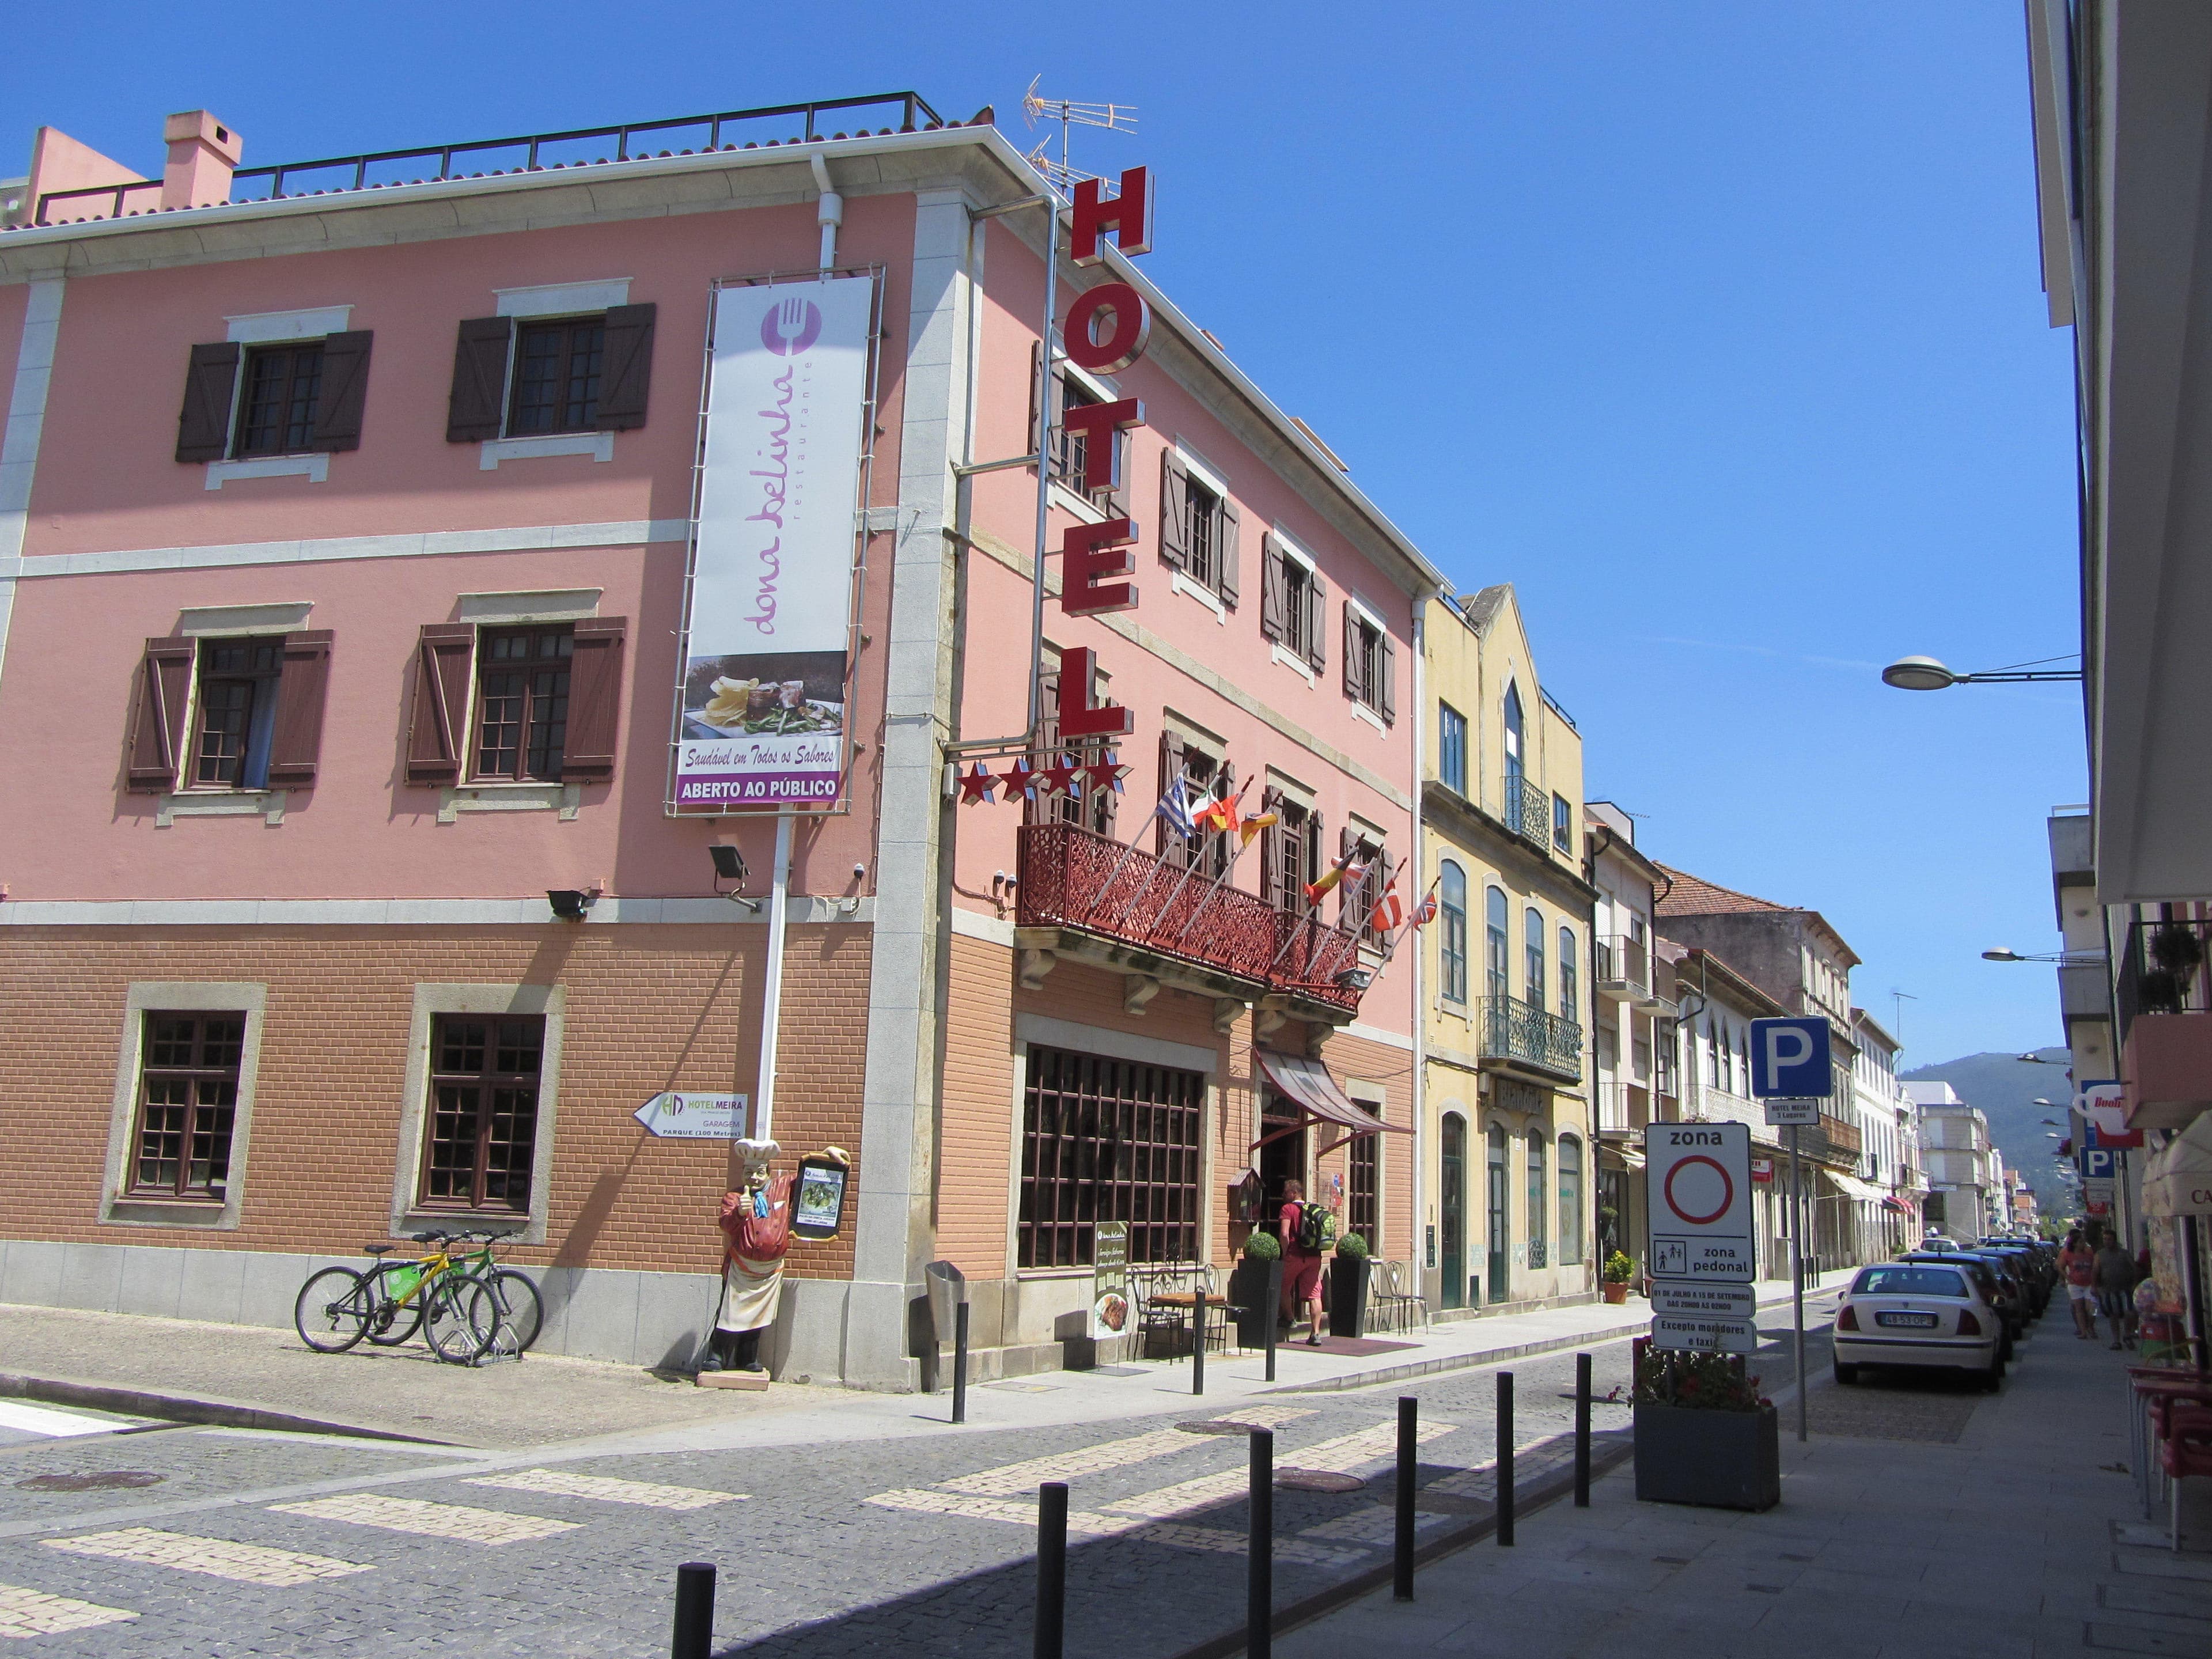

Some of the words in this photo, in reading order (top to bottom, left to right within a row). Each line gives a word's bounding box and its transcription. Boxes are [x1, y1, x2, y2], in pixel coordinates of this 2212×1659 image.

[744, 364, 793, 529] belinha
[793, 362, 812, 520] restaurante
[1059, 166, 1153, 738] HOTEL
[744, 536, 780, 635] dona
[685, 747, 732, 767] Saudável
[733, 753, 747, 765] em
[751, 744, 778, 766] Todos
[781, 752, 791, 763] os
[794, 743, 834, 765] Sabores
[681, 781, 740, 798] ABERTO
[744, 781, 766, 797] AO
[770, 777, 836, 797] PÚBLICO
[1766, 1027, 1813, 1089] P
[1670, 1131, 1723, 1145] zona
[2087, 1151, 2109, 1175] P
[1704, 1247, 1736, 1258] zona
[1694, 1260, 1748, 1272] pedonal
[1717, 1293, 1749, 1301] SETEMBRO
[1661, 1320, 1695, 1331] Excepto
